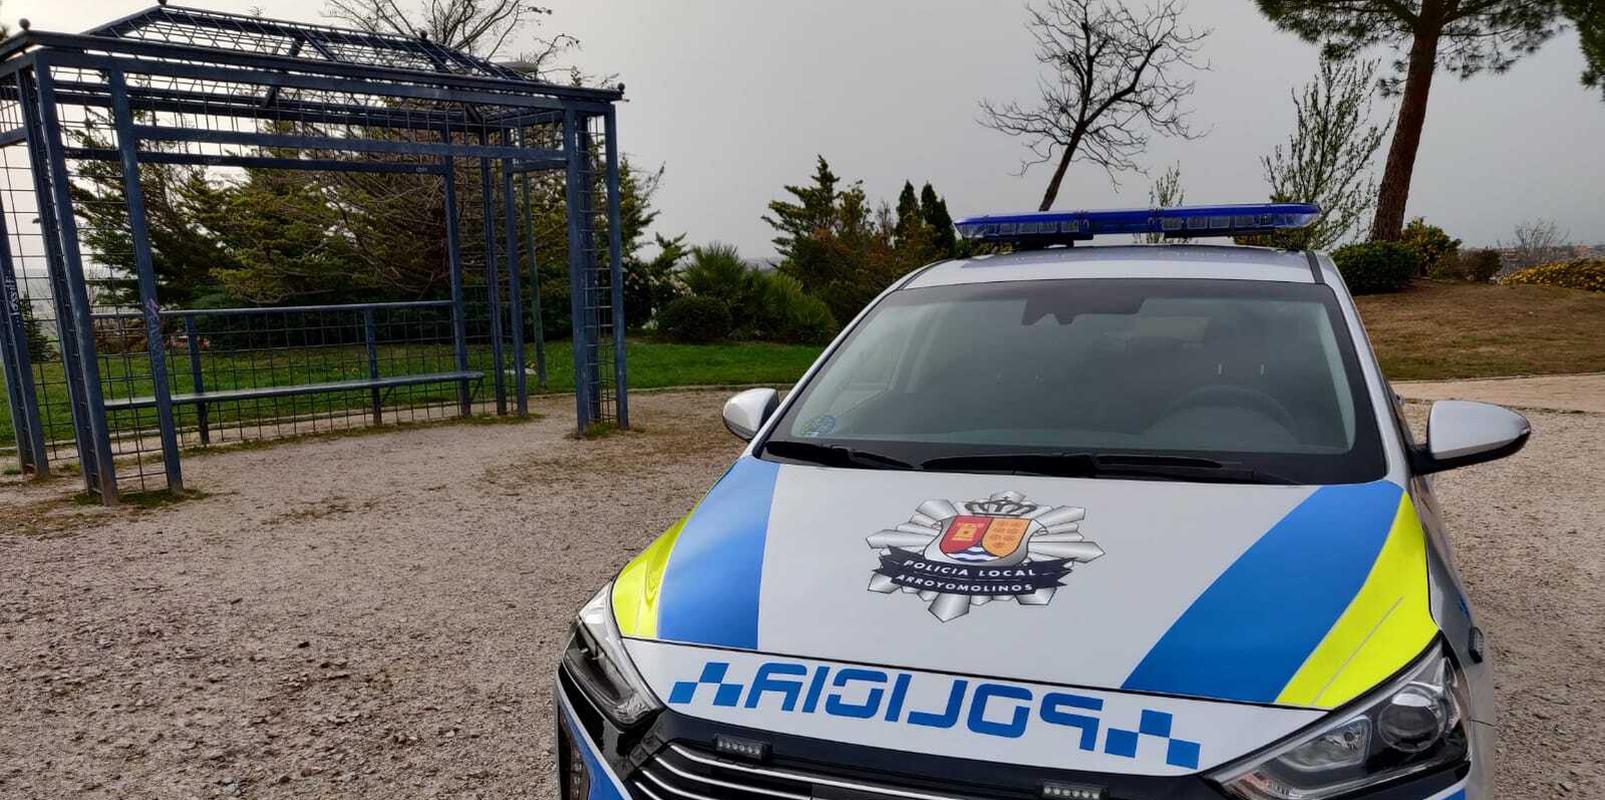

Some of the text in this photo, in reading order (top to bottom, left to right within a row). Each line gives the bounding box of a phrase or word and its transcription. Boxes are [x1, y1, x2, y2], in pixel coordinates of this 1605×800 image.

[903, 559, 1036, 577] POLICIA LOCAL
[895, 573, 1034, 592] ARROYOMOLINOS
